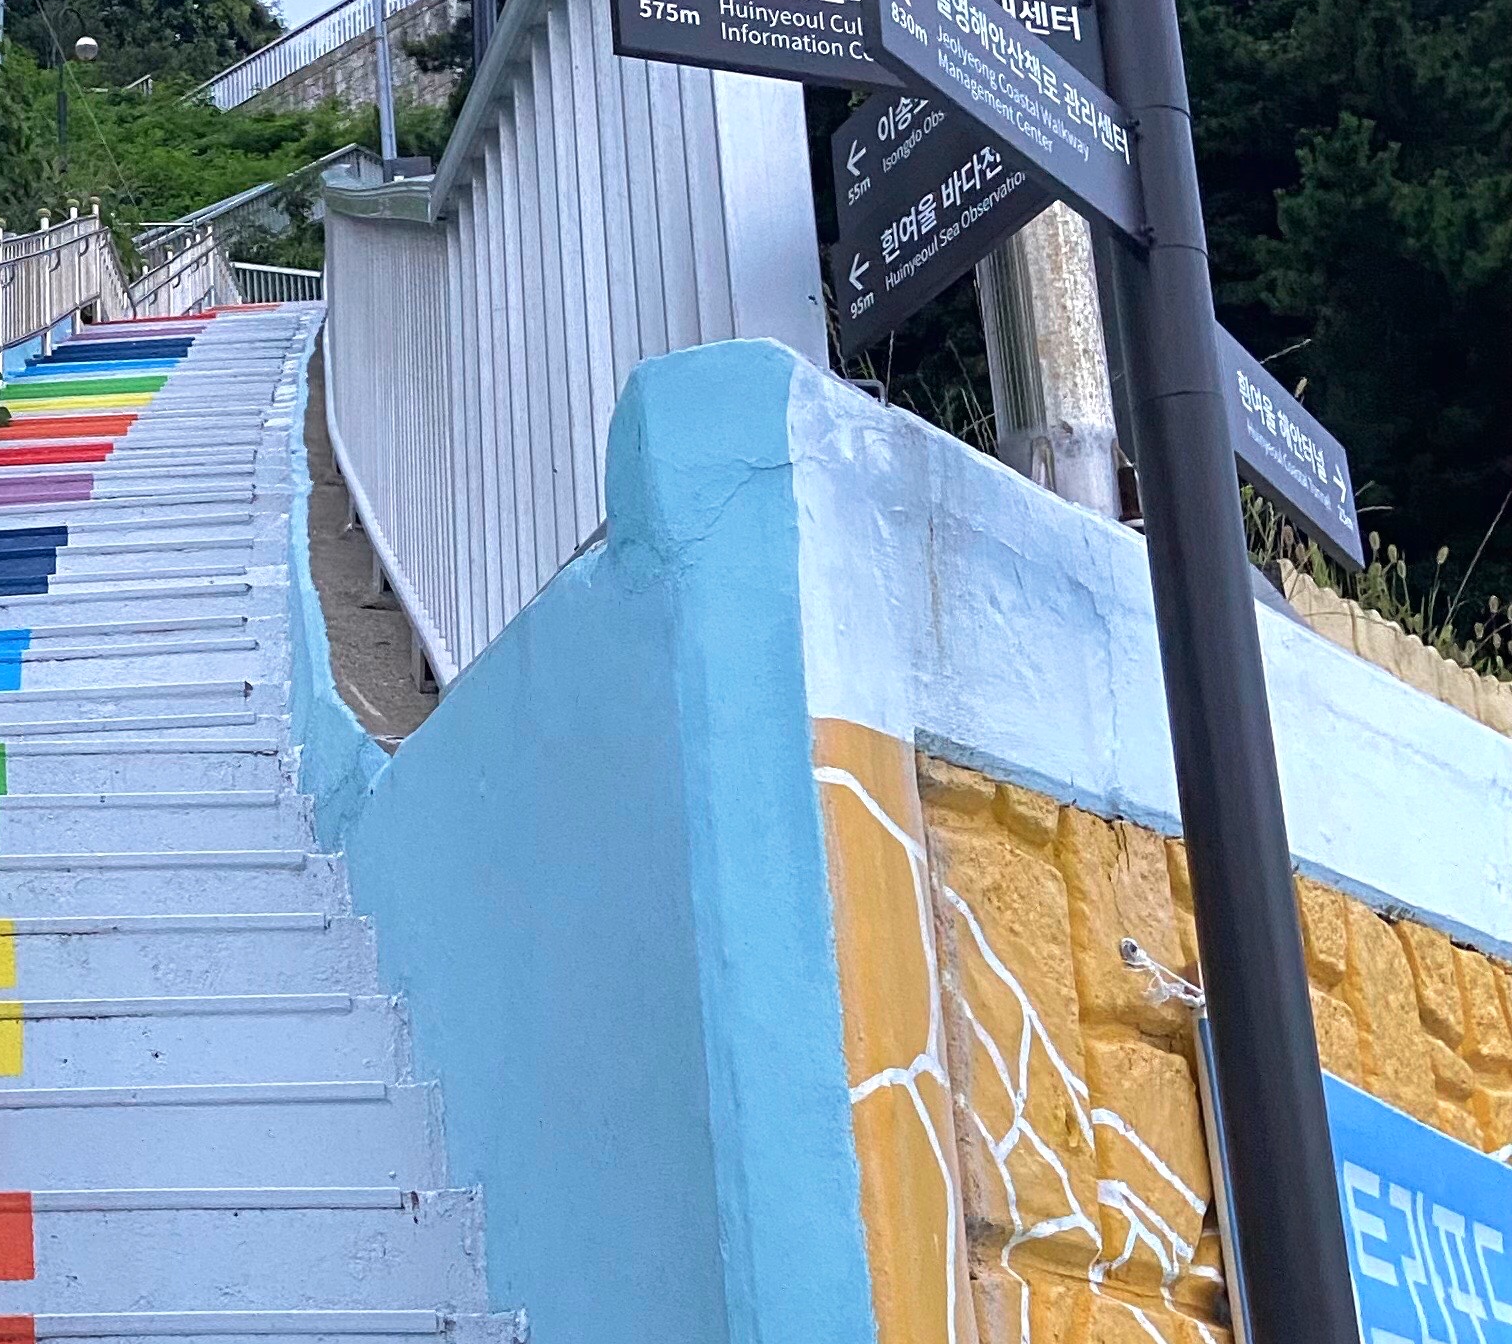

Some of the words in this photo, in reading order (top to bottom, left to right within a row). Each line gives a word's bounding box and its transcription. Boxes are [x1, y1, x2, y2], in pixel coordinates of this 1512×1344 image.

[721, 22, 844, 58] Information
[890, 1, 928, 47] 830m
[936, 25, 998, 91] Jeolyeong
[998, 73, 1039, 117] Coastal
[1040, 105, 1090, 163] Walkway
[938, 48, 1015, 112] Management
[1015, 109, 1054, 154] Center
[1062, 82, 1131, 165] 관리센터
[882, 127, 923, 174] Isongdo
[848, 176, 872, 206] 55m
[880, 192, 938, 265] 흰여울
[885, 234, 939, 292] Huinyeoul
[938, 222, 961, 248] Sea
[850, 291, 875, 320] 95m
[1237, 369, 1278, 437] 흰여울
